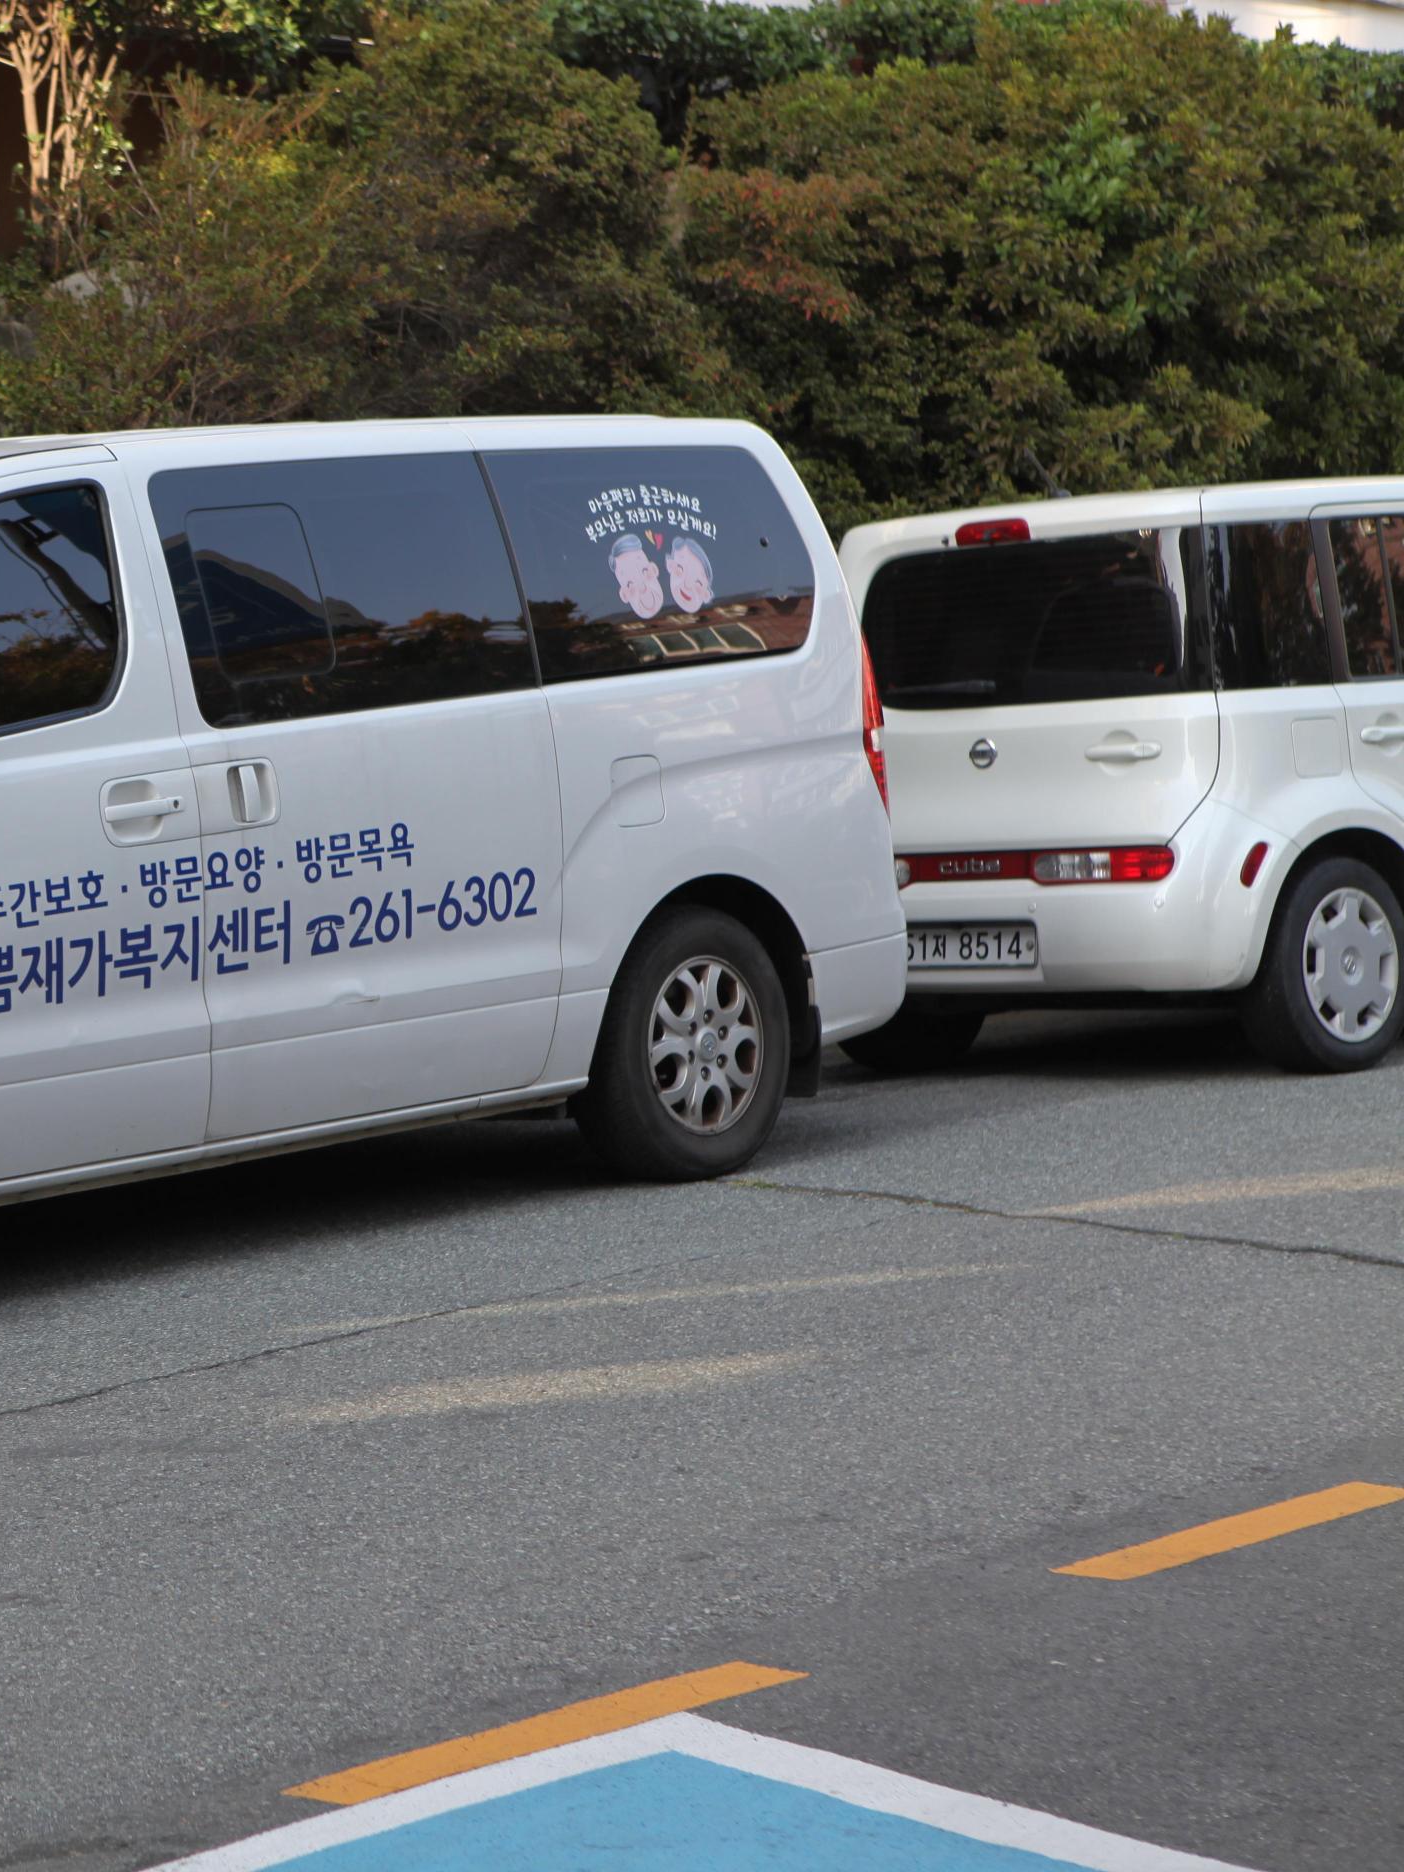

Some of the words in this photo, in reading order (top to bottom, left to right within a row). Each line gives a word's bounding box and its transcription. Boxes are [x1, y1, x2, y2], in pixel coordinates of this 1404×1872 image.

[588, 487, 636, 513] 마음편히
[639, 484, 702, 513] 출근하세요
[585, 511, 625, 543] 부모님은
[625, 507, 664, 525] 저희가
[139, 846, 266, 909] 방문요양
[296, 822, 415, 884] 방문목욕
[938, 858, 1001, 874] cube
[348, 866, 538, 948] 261-6302
[959, 931, 1023, 961] 8514
